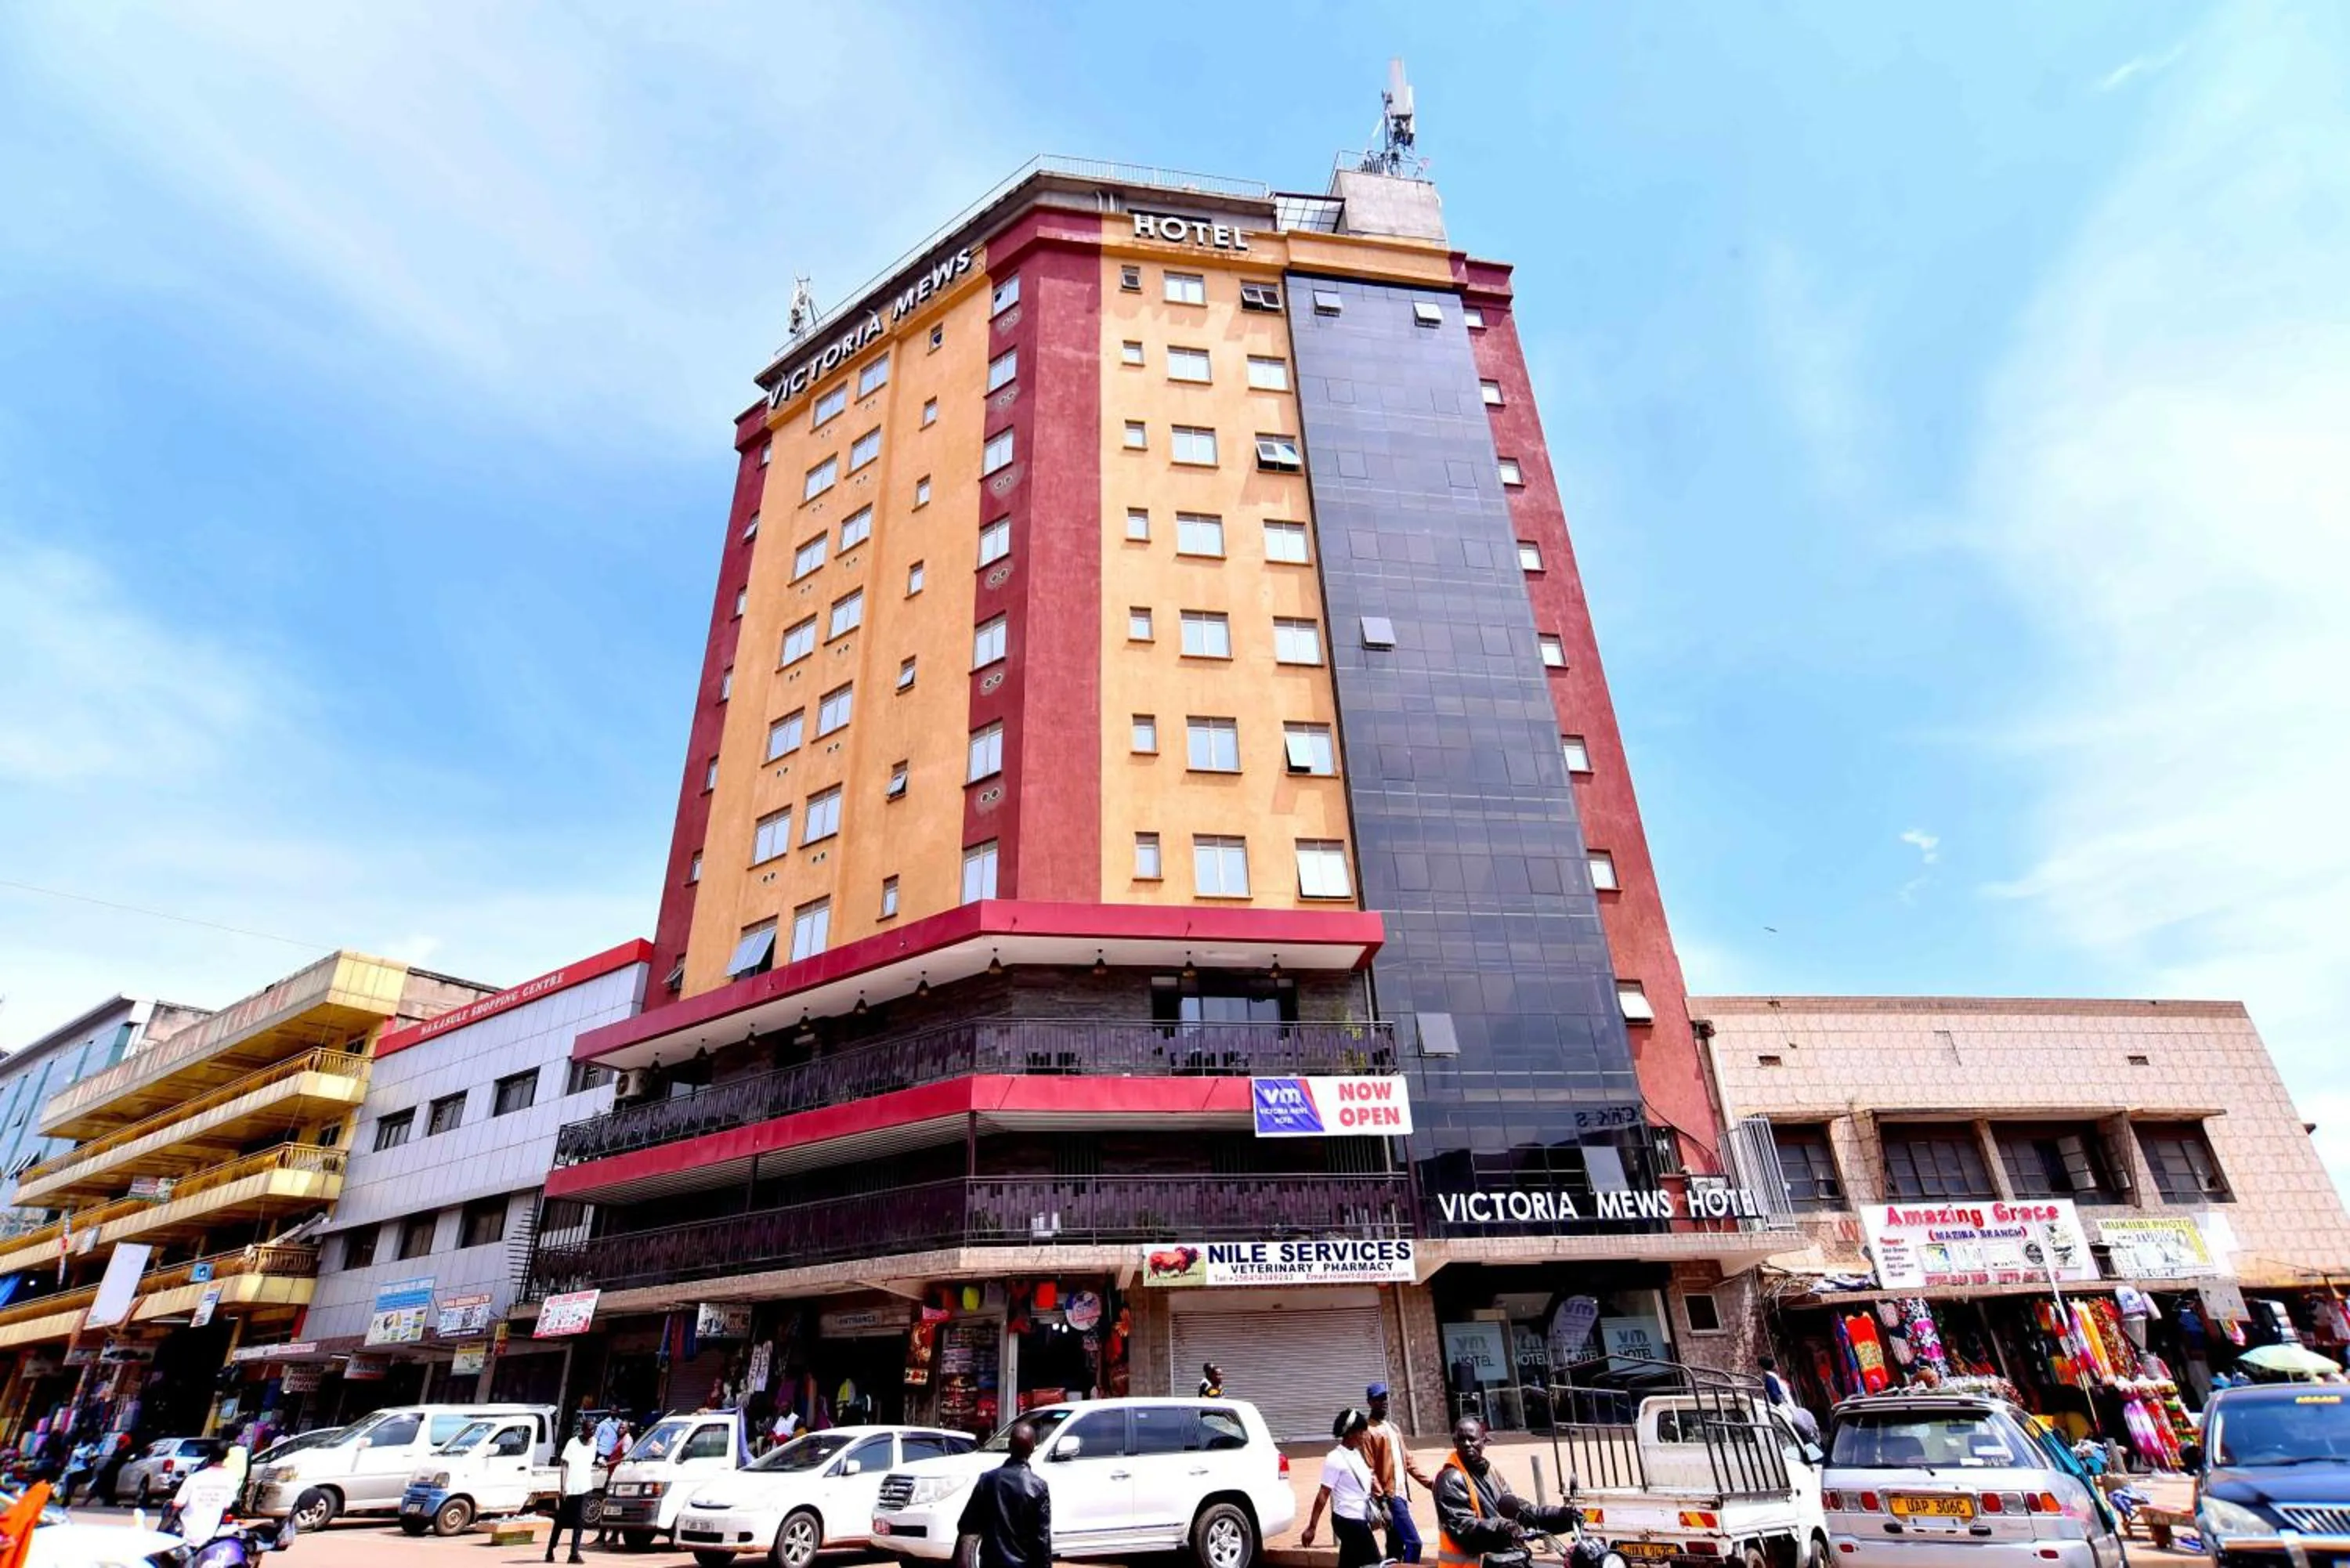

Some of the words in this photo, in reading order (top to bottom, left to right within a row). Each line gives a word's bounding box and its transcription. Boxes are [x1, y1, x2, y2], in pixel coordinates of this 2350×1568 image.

[1133, 213, 1249, 251] HOTEL
[768, 312, 884, 409] VICTORIA
[892, 247, 972, 322] MEWS
[472, 990, 519, 1017] SHOPPING
[522, 971, 565, 997] CENTRE
[1339, 1082, 1392, 1102] NOW
[1339, 1107, 1401, 1127] OPEN
[1438, 1191, 1579, 1222] VICTORIA
[1596, 1190, 1673, 1219] MEWS
[1886, 1205, 1984, 1228] Amazing
[1992, 1201, 2059, 1223] Grace
[1208, 1244, 1267, 1263] NILE
[1280, 1241, 1411, 1263] SERVICES
[1231, 1263, 1314, 1274] VETERINARY
[1323, 1262, 1394, 1273] PHARMACY
[1906, 1498, 1929, 1512] UAP
[1933, 1498, 1965, 1514] 306C
